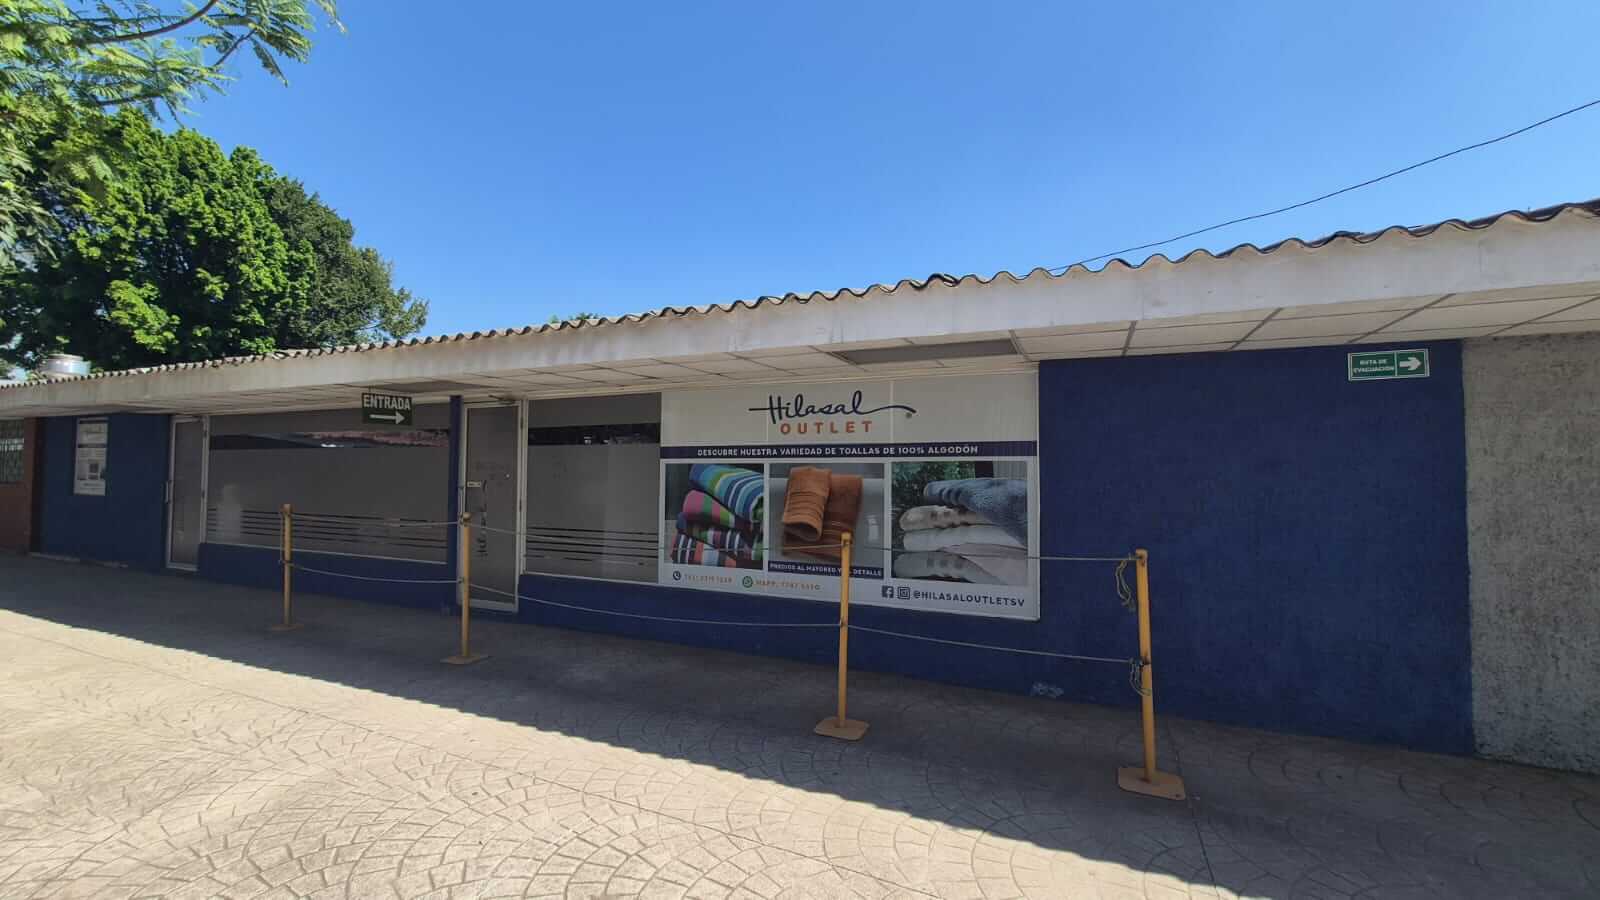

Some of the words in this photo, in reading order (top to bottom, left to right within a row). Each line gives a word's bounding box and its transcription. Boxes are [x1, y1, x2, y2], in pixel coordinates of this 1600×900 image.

[363, 394, 411, 410] ENTRADA
[749, 390, 917, 425] Hilasal
[780, 421, 872, 434] OUTLET
[697, 448, 738, 456] DESCUBRE
[740, 448, 777, 456] NUESTRA
[780, 448, 822, 456] VARIEDAD
[825, 447, 836, 455] DE
[840, 447, 880, 455] TOALLAS
[883, 447, 895, 455] DE
[913, 589, 1025, 606] @HILASALOUTLETSV
